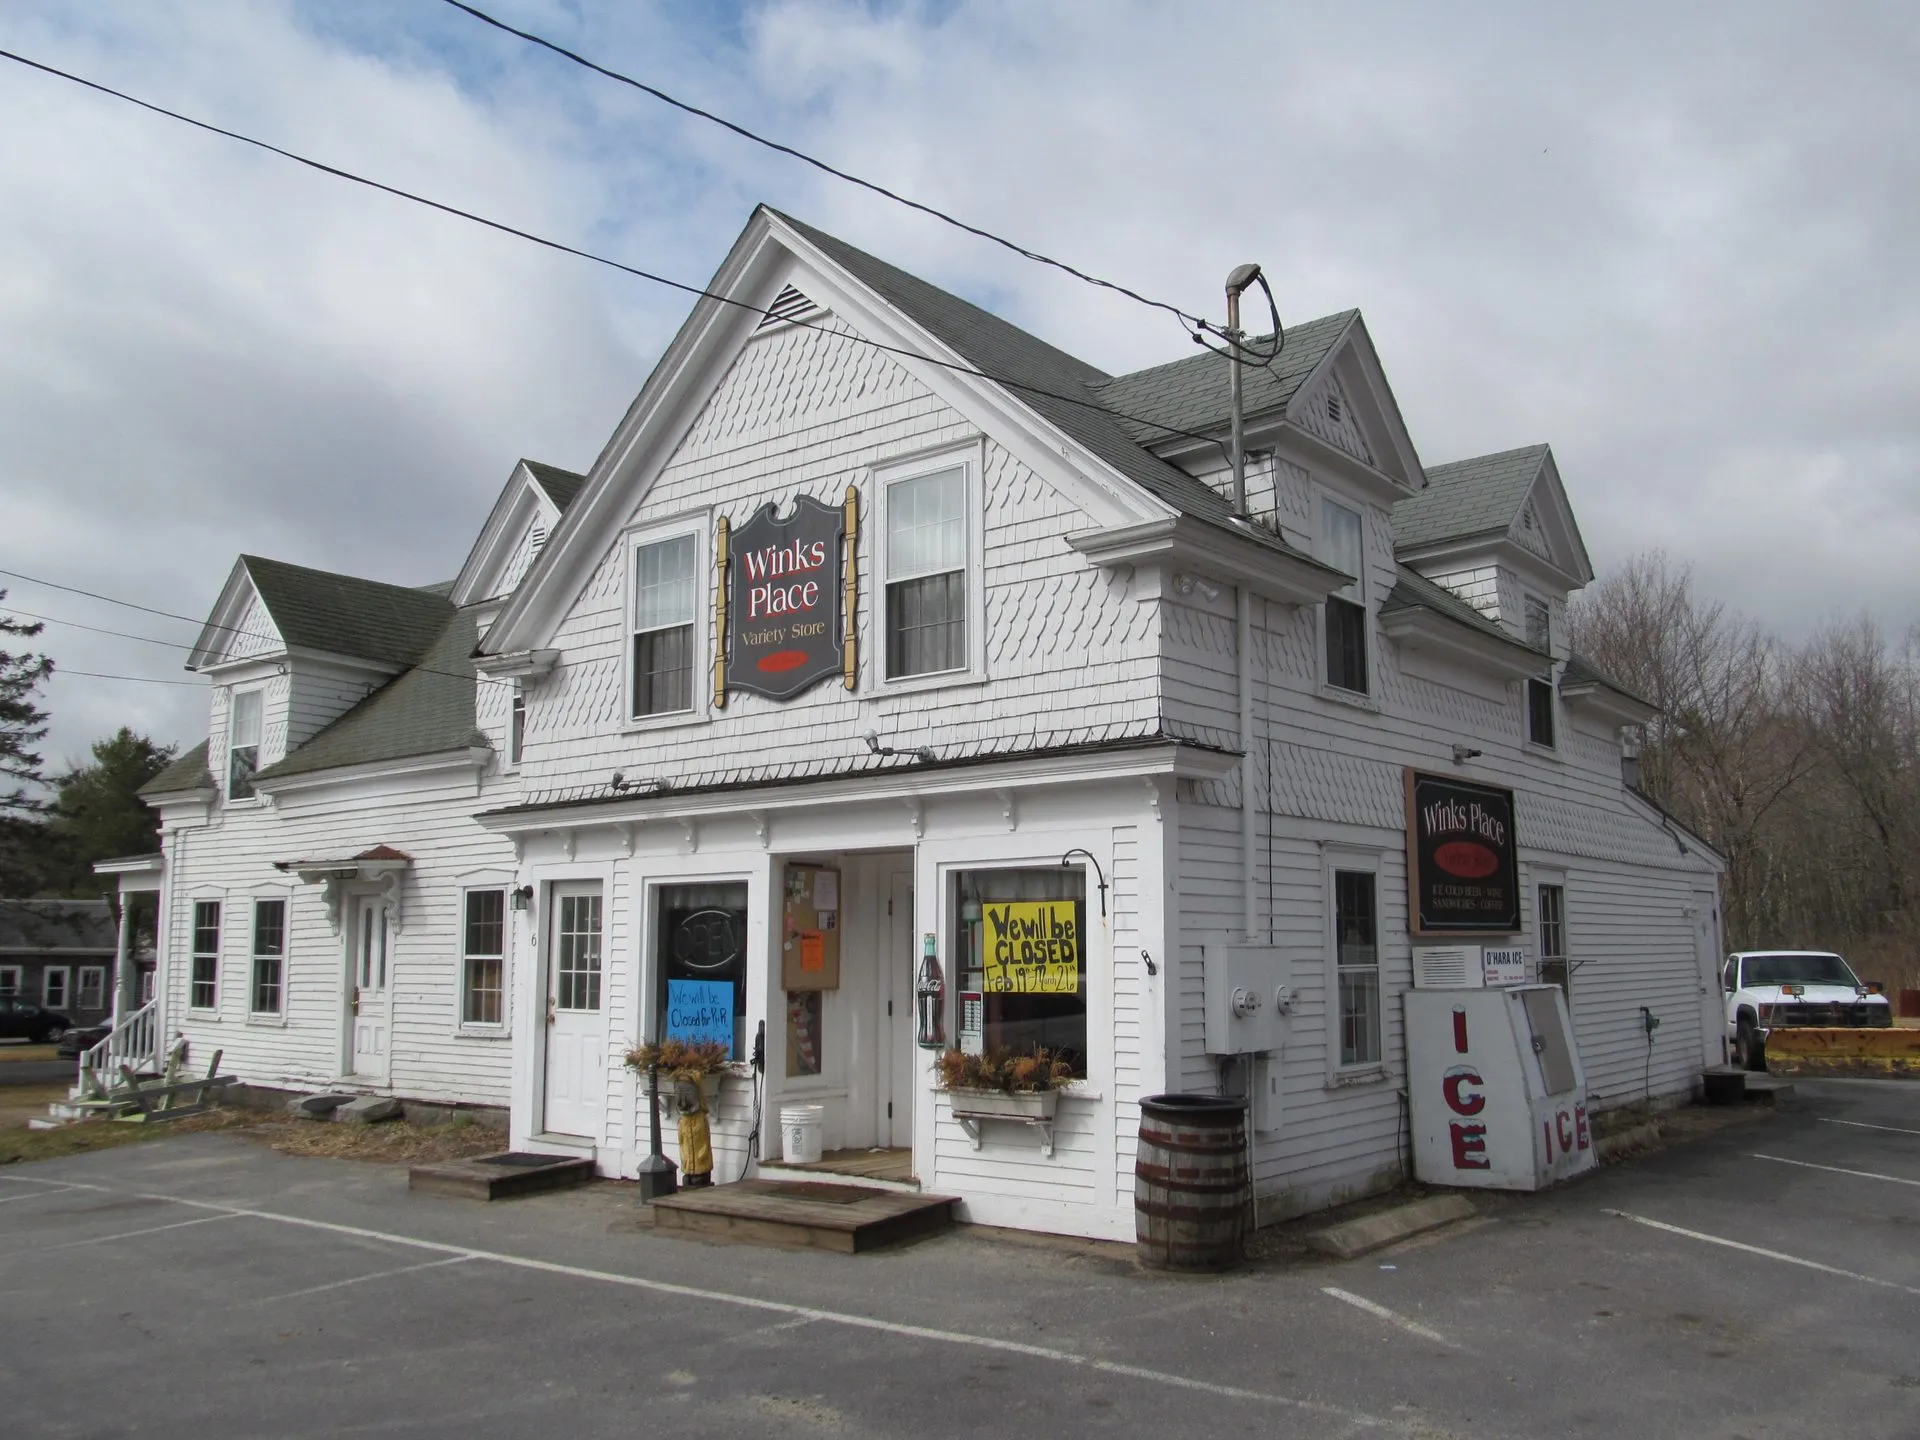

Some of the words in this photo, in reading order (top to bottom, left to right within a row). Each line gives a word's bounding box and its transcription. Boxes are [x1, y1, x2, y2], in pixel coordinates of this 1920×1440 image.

[745, 538, 826, 580] Winks
[749, 581, 819, 618] Place
[742, 628, 787, 646] Variety
[791, 621, 825, 639] Store
[1424, 798, 1467, 835] Winks
[1470, 803, 1504, 846] Place
[988, 905, 1020, 940] We
[1019, 907, 1047, 940] will
[1049, 906, 1075, 940] be
[531, 932, 537, 947] 6
[995, 939, 1075, 966] CLOSED
[1486, 951, 1511, 965] O'HARA
[1512, 951, 1523, 965] ICE
[670, 983, 688, 1005] We
[986, 965, 1014, 992] Feb
[1443, 1004, 1491, 1169] ICE
[1543, 1101, 1590, 1164] ICE
